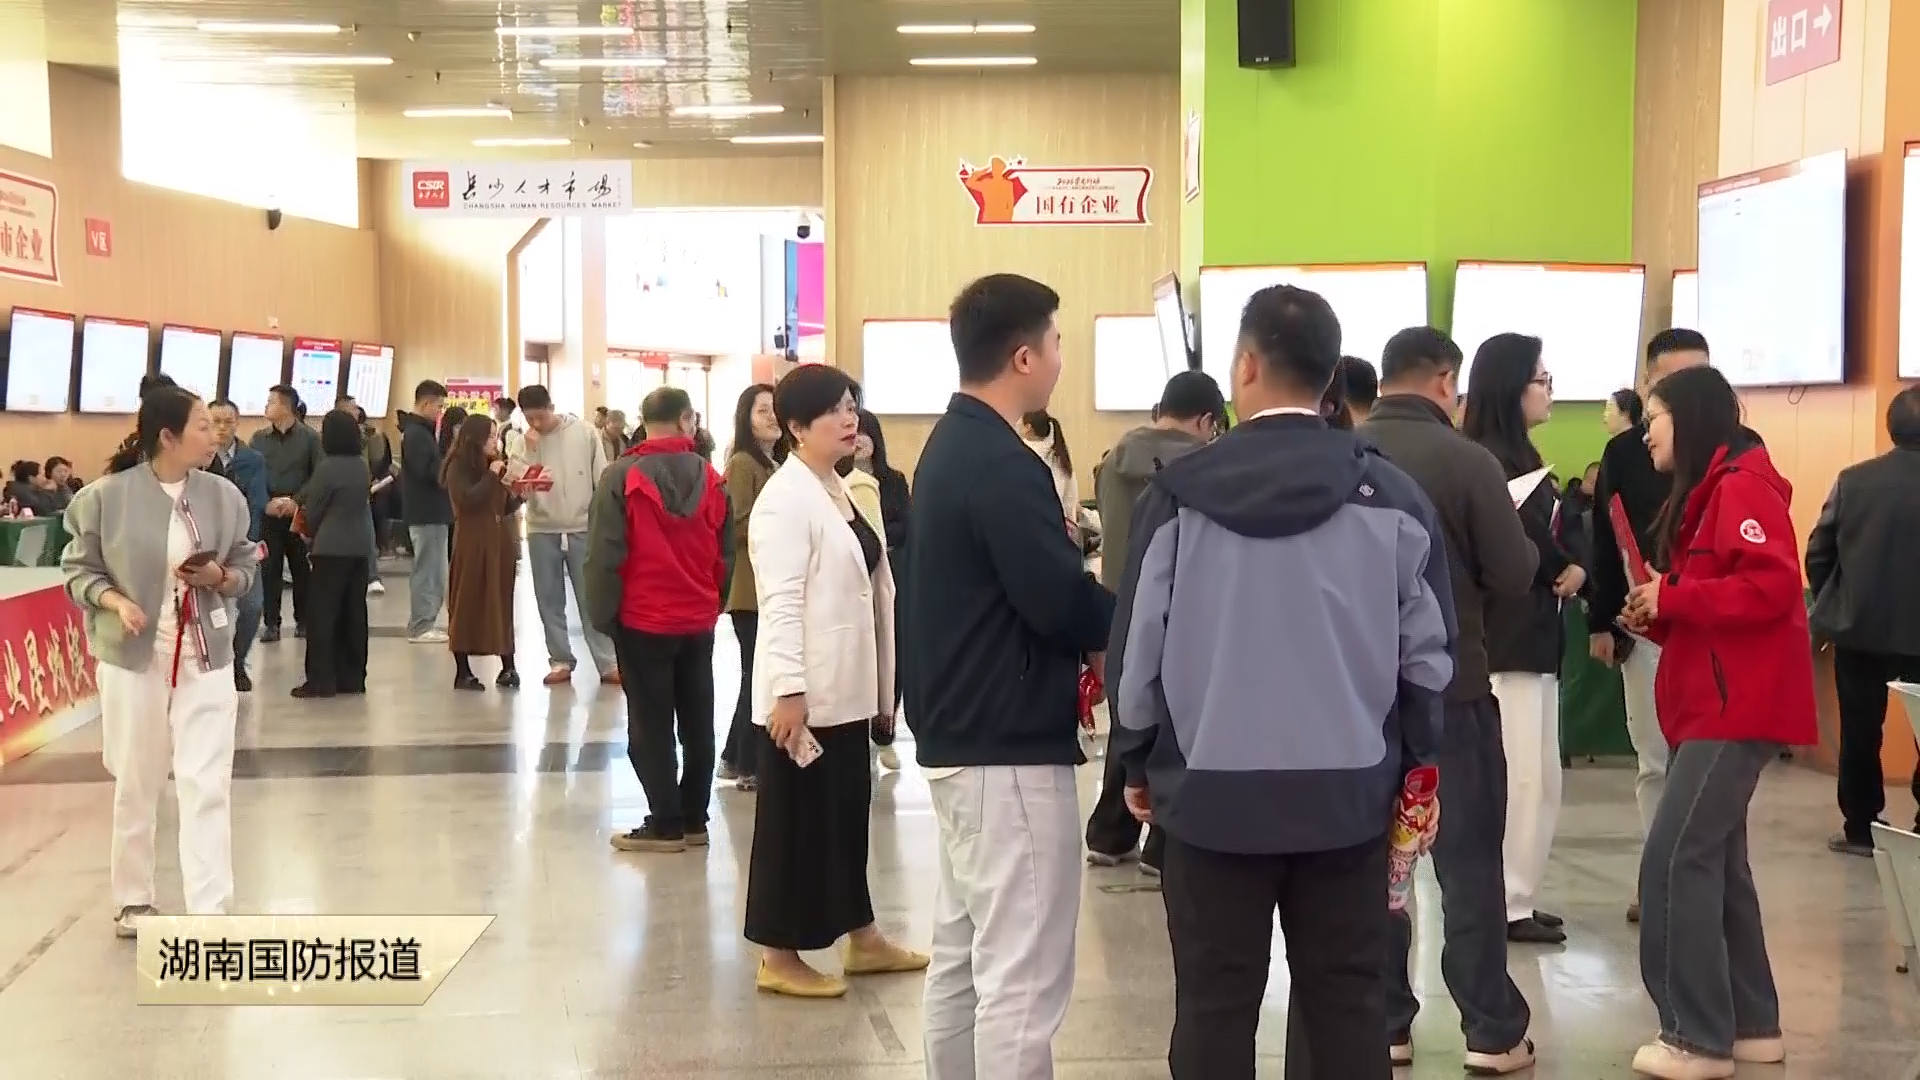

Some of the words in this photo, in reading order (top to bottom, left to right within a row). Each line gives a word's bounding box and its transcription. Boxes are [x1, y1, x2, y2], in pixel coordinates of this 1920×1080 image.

[1770, 8, 1808, 58] 出口
[1036, 195, 1119, 214] 国有企业
